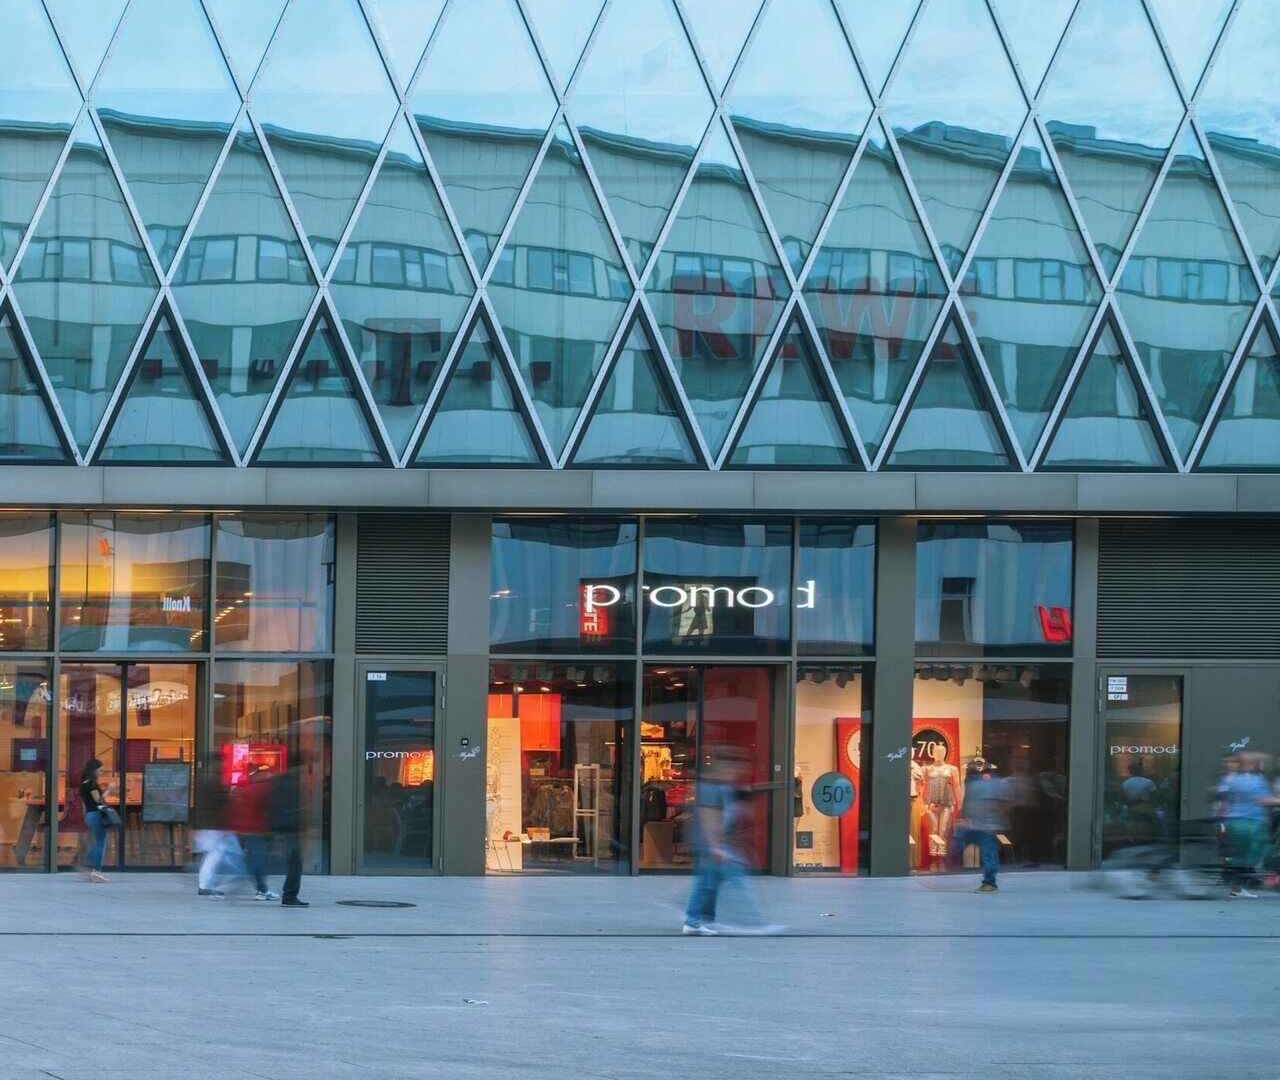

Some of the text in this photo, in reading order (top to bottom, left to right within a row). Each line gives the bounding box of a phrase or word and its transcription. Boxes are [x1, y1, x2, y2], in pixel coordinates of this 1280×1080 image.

[585, 580, 816, 613] pomod
[365, 749, 433, 761] promod
[1110, 744, 1177, 756] promod
